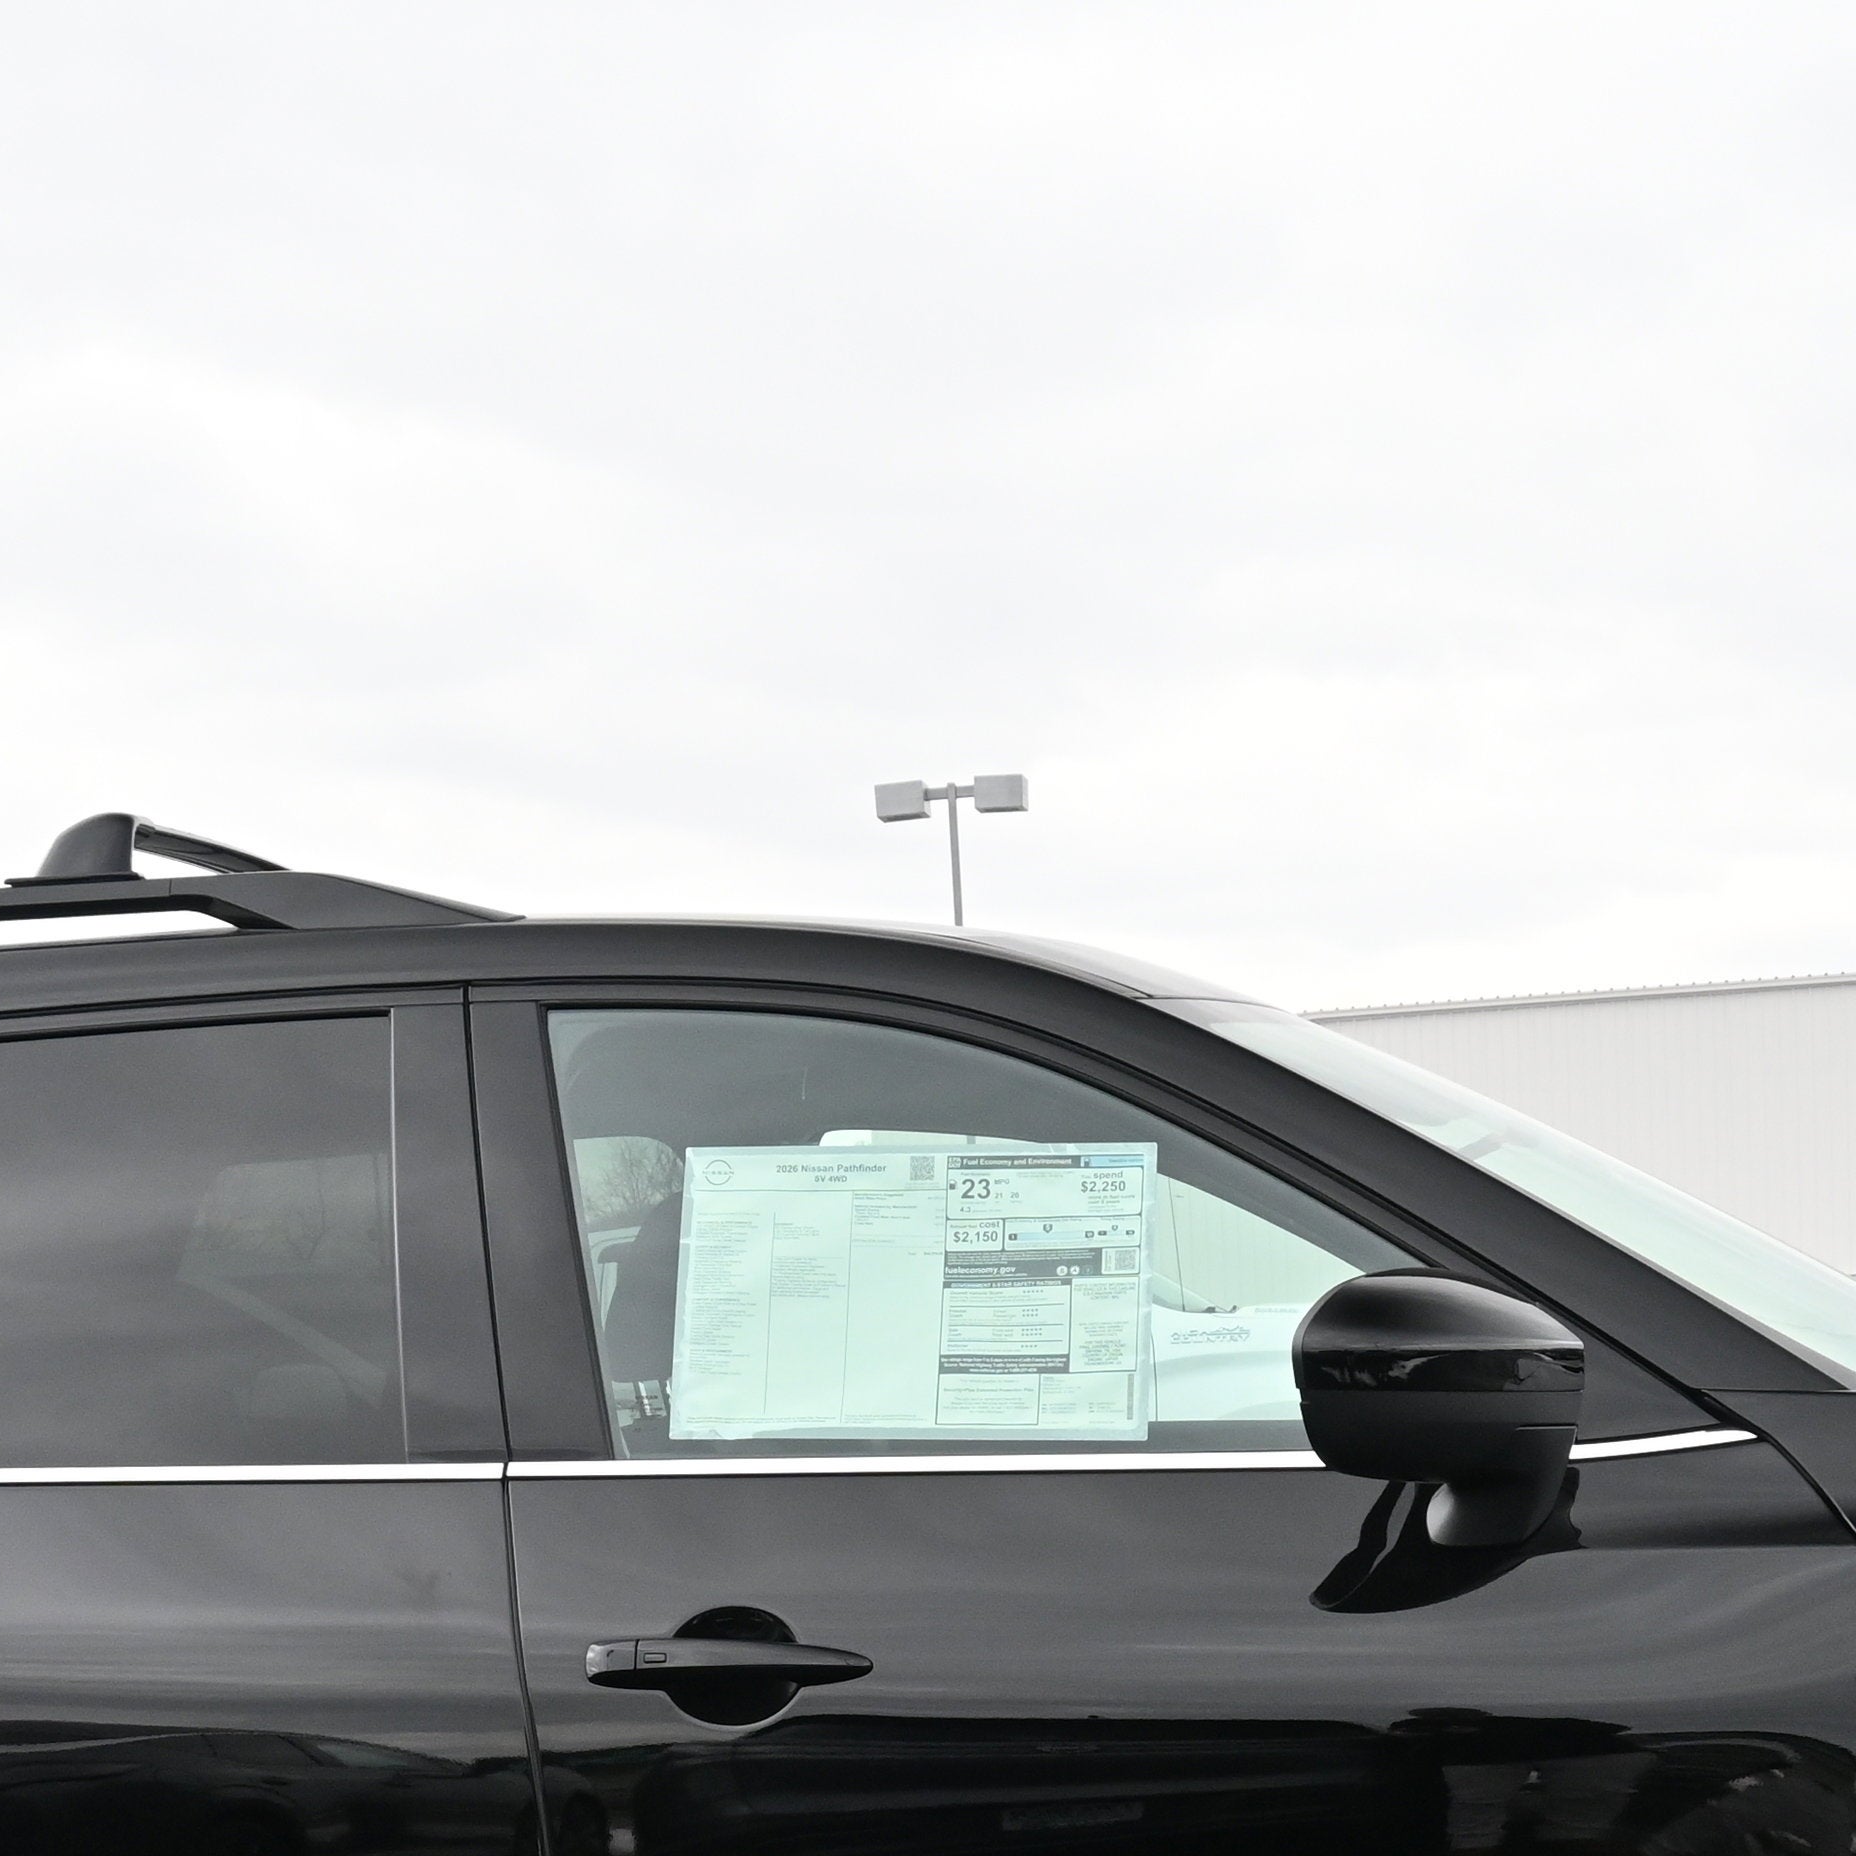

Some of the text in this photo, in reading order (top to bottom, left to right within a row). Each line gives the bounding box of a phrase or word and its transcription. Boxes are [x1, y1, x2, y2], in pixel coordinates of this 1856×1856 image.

[980, 1158, 1012, 1166] Economy
[776, 1163, 886, 1173] 2026 Nissan Pathfinder
[828, 1175, 847, 1183] 4WD
[1093, 1171, 1123, 1180] spend
[960, 1178, 991, 1199] 23
[1081, 1181, 1126, 1193] $2,250
[979, 1221, 1000, 1229] cost
[953, 1231, 998, 1244] $2,150
[945, 1266, 1016, 1275] fueleconomy.gov
